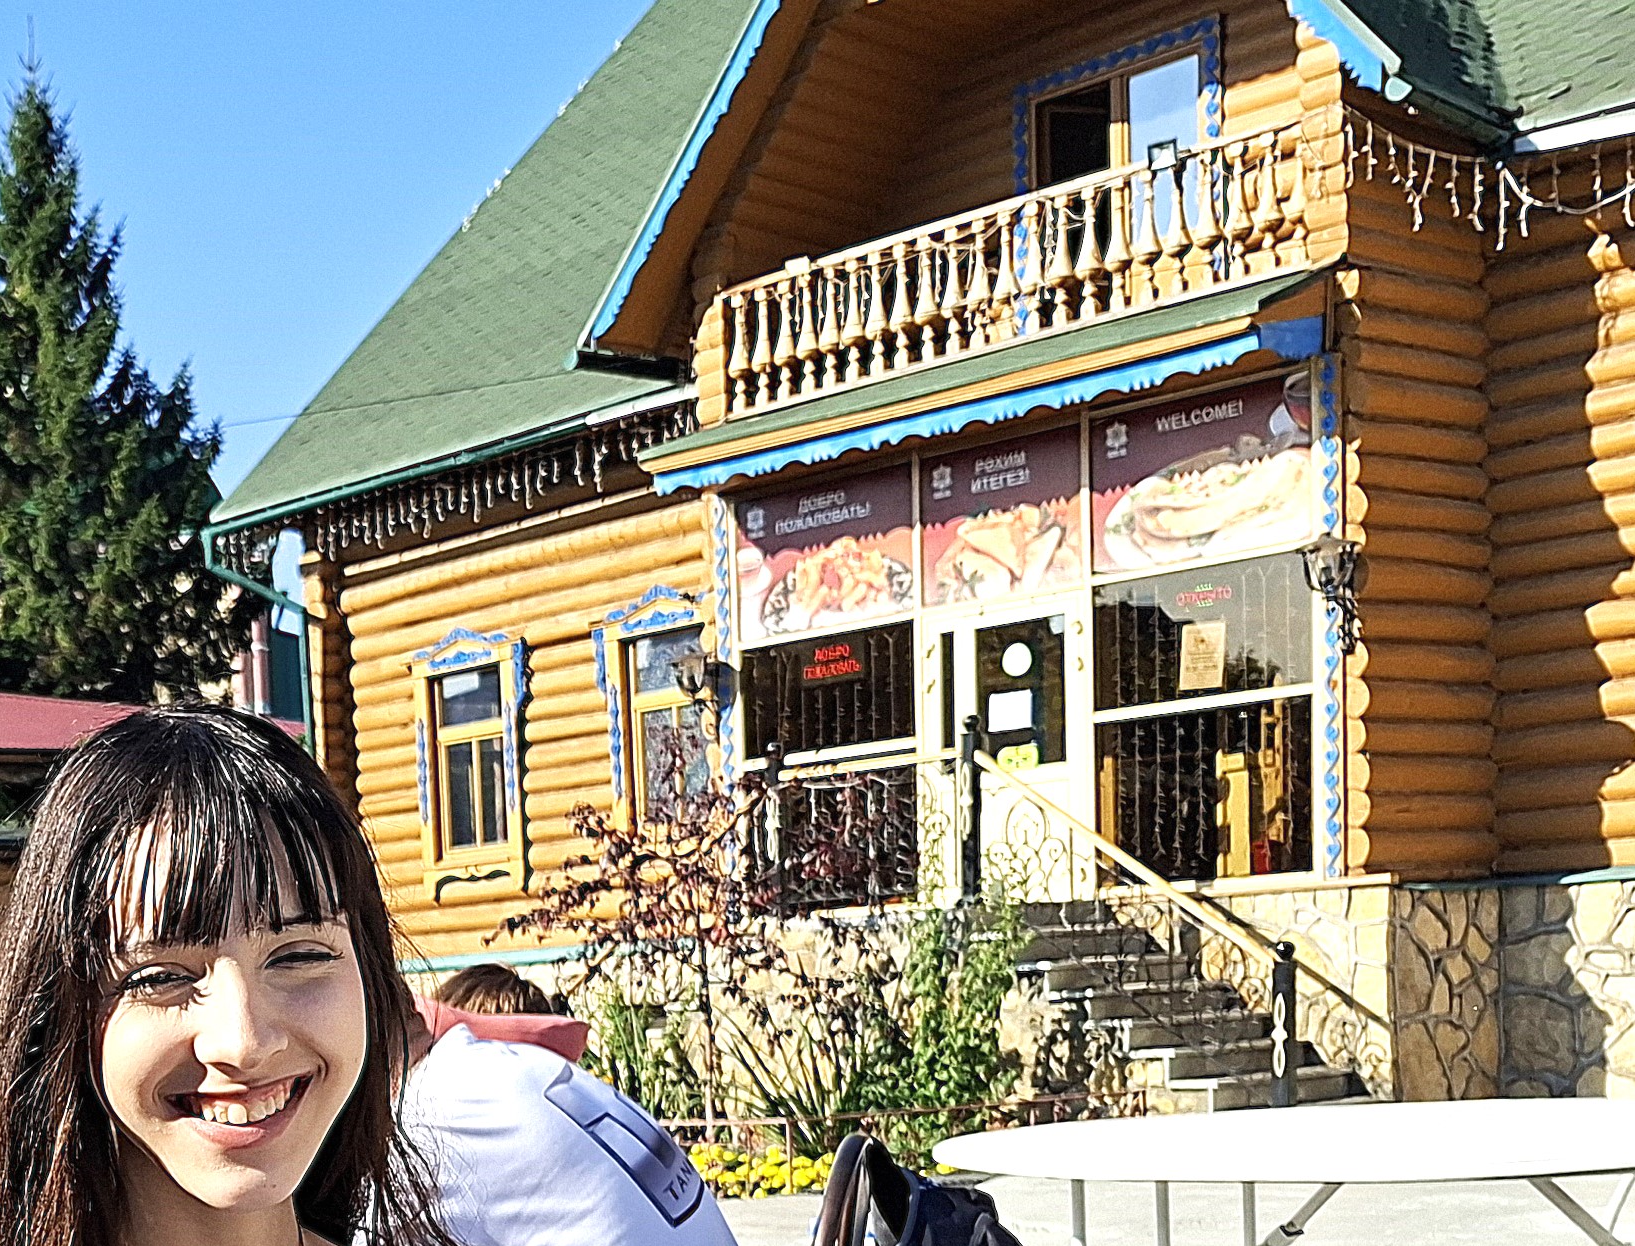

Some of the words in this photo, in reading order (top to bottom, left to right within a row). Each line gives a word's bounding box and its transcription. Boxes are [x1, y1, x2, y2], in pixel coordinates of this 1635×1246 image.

[1156, 398, 1243, 433] WELCOME!
[798, 490, 846, 515] ДОБРО
[814, 643, 851, 663] ДОБРО
